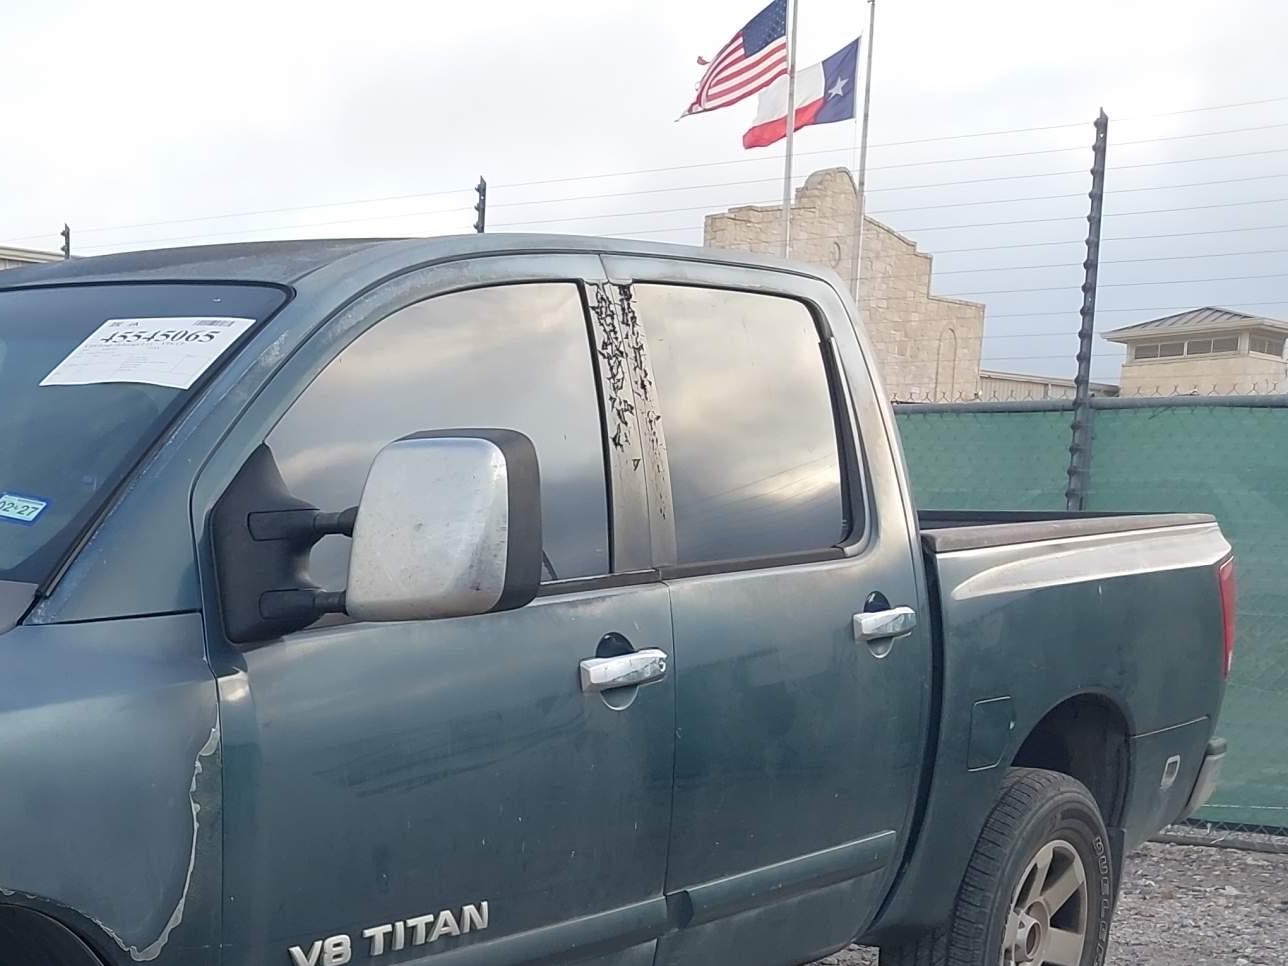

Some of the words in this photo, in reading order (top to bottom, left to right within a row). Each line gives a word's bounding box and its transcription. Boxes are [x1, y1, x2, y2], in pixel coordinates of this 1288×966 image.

[100, 330, 220, 343] 45545065
[17, 505, 40, 516] 27
[363, 901, 489, 957] TITAN
